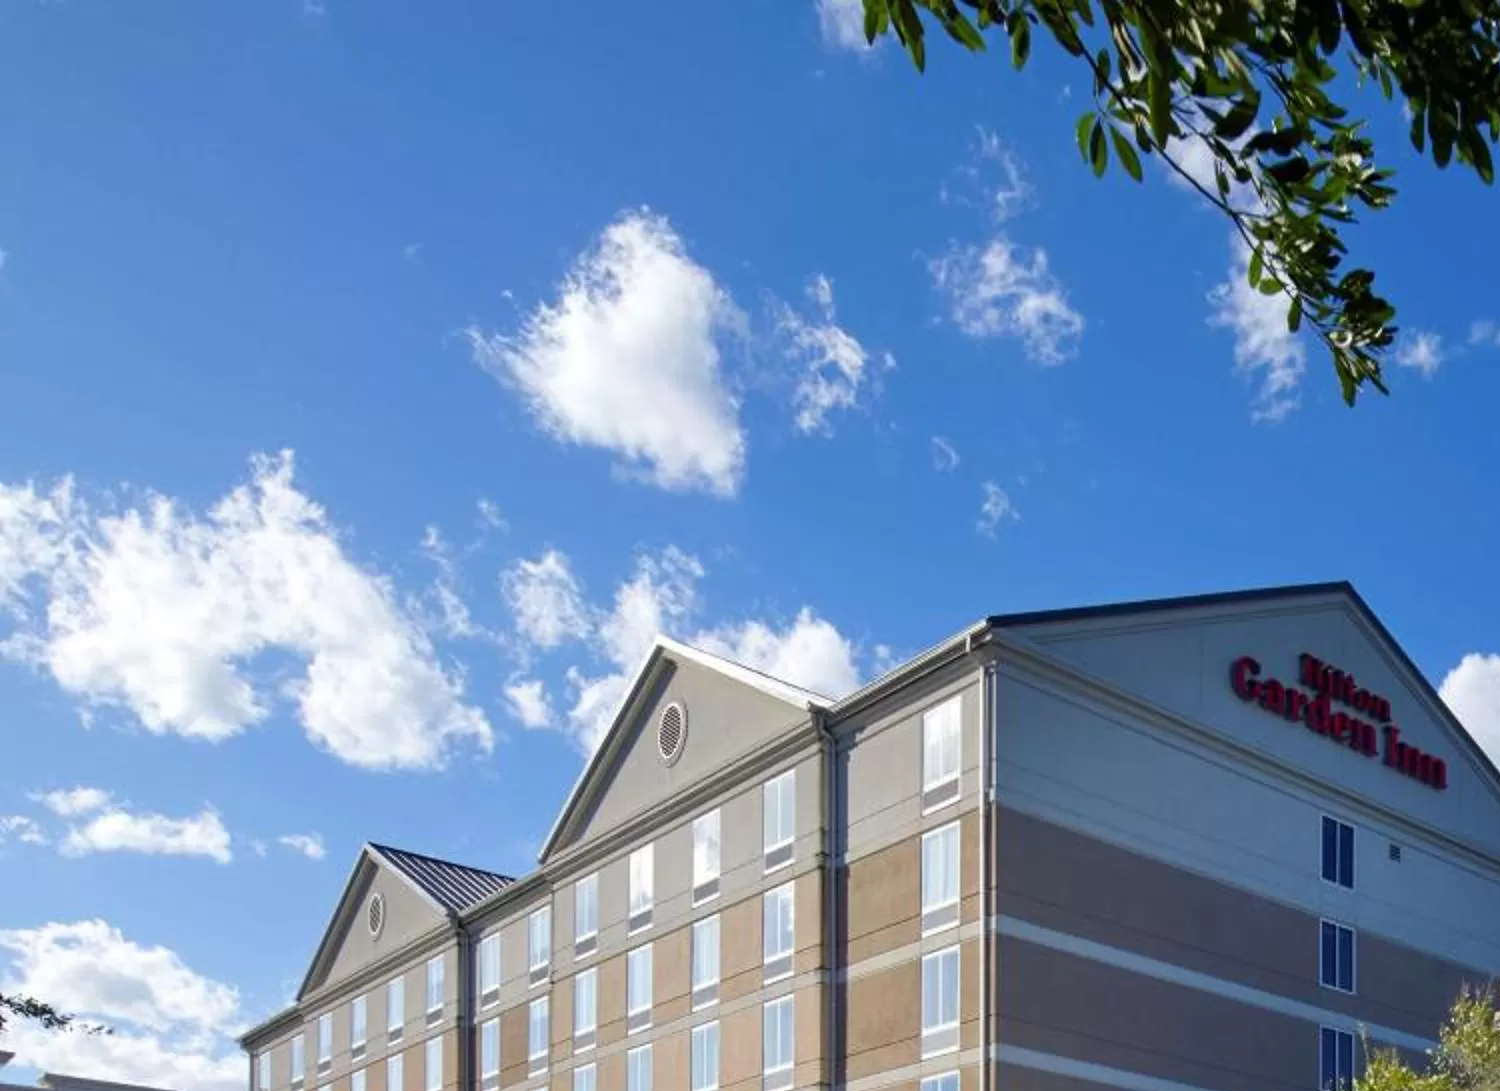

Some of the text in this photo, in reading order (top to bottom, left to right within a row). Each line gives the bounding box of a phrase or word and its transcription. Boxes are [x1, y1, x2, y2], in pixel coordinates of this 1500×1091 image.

[1230, 656, 1448, 790] Garden Inn
[1299, 652, 1391, 722] Hilton
